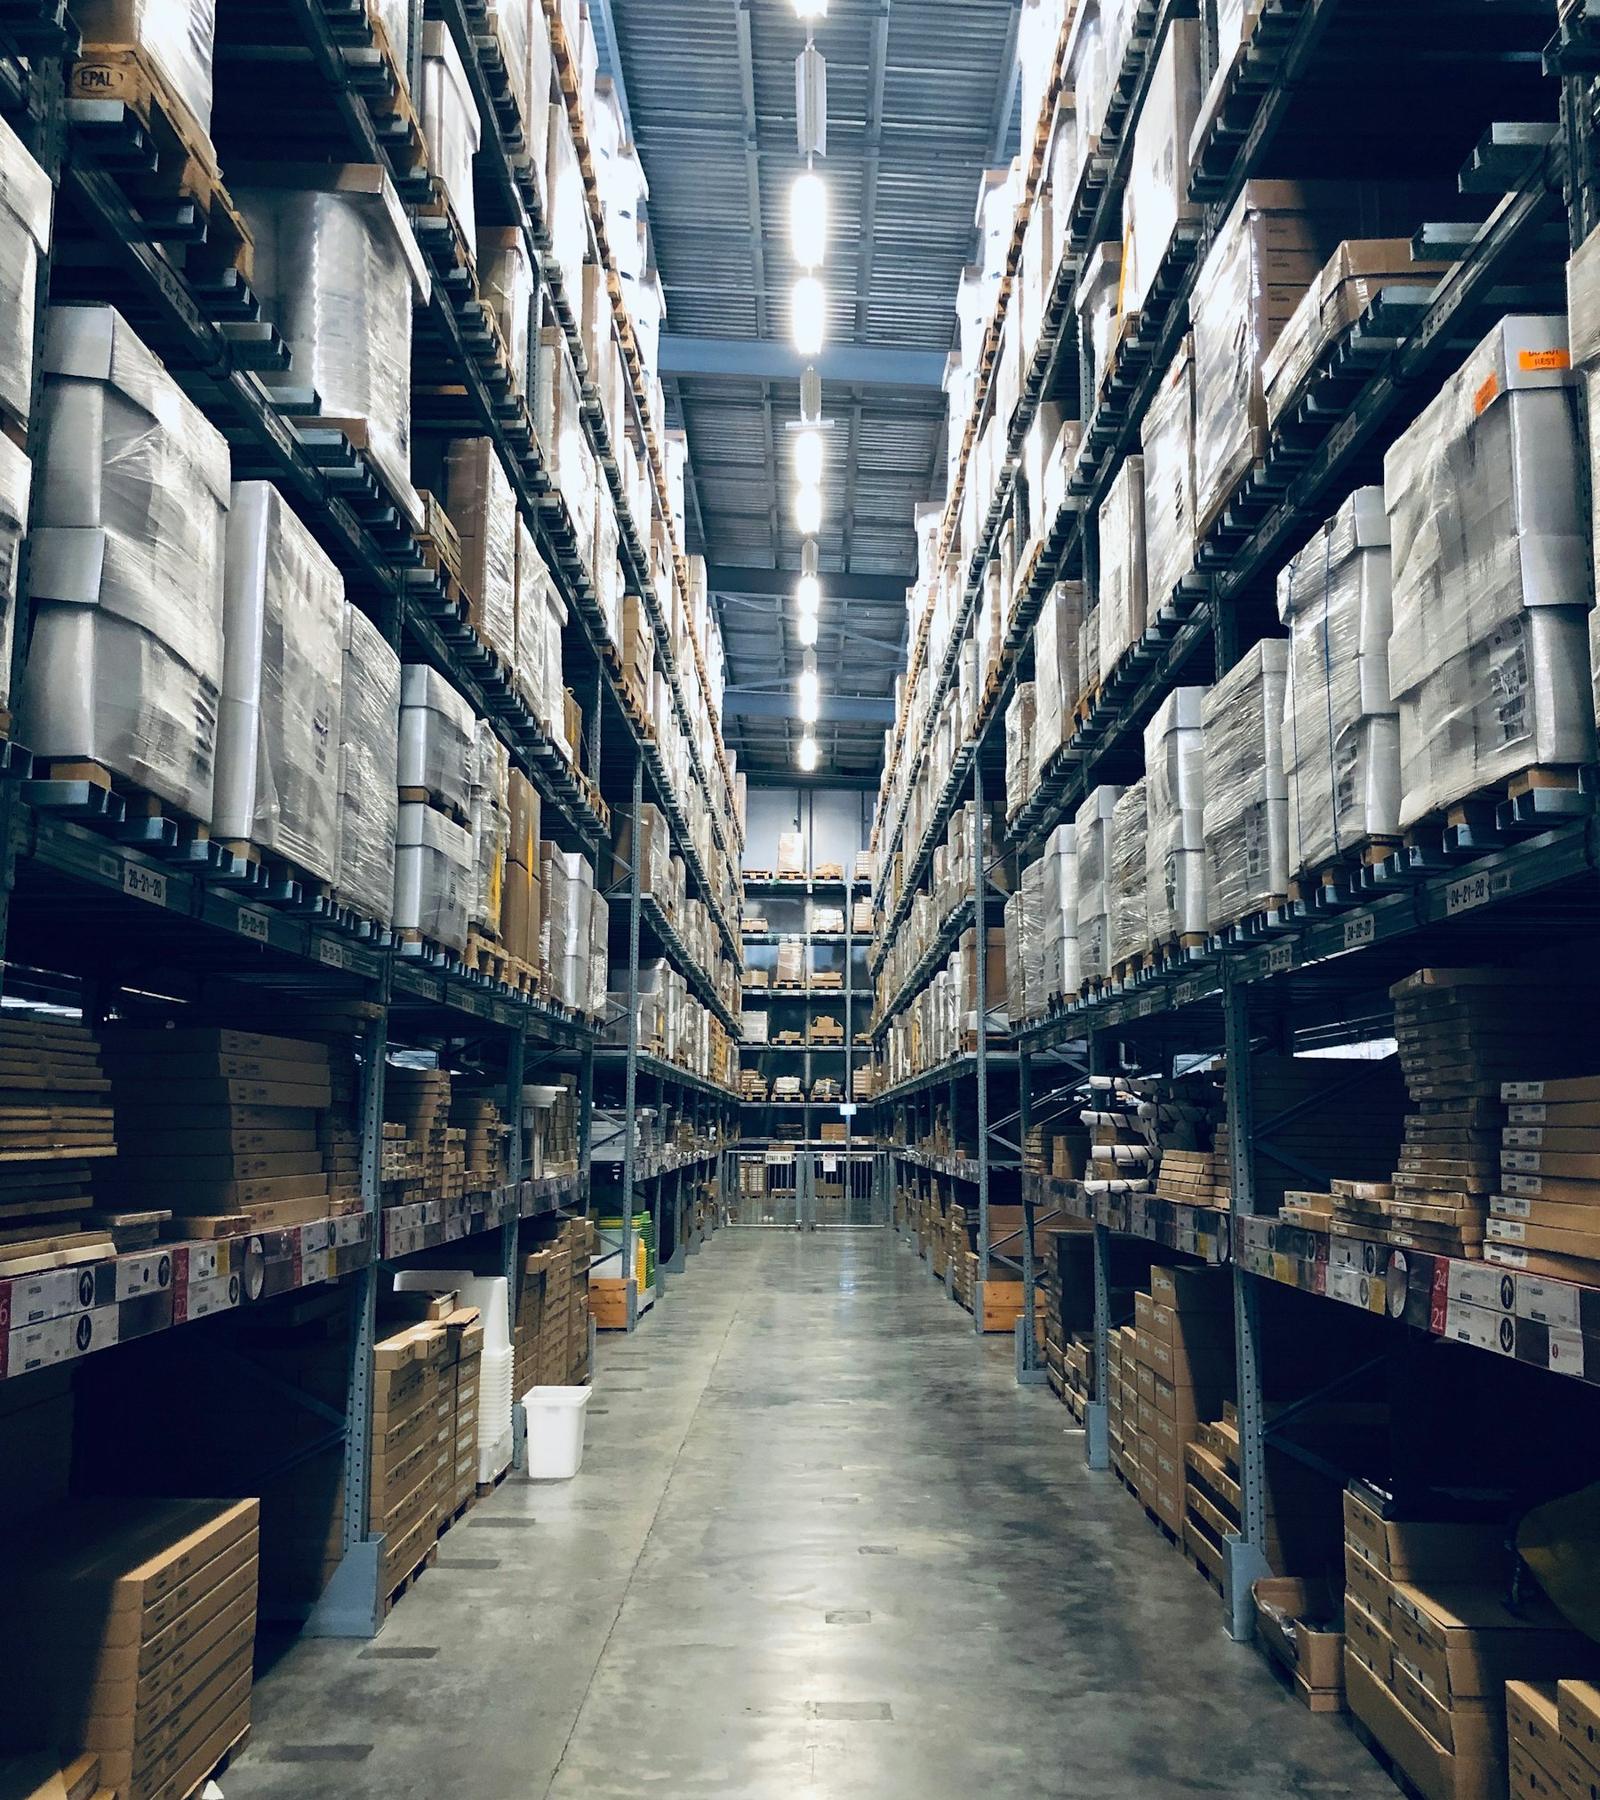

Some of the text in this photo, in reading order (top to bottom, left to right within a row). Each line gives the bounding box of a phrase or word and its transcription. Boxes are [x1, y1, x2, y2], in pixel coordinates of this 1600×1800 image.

[81, 71, 114, 86] EPAL
[1450, 878, 1485, 907] 24-21-20
[1434, 1269, 1447, 1290] 24
[1431, 1308, 1444, 1330] 21
